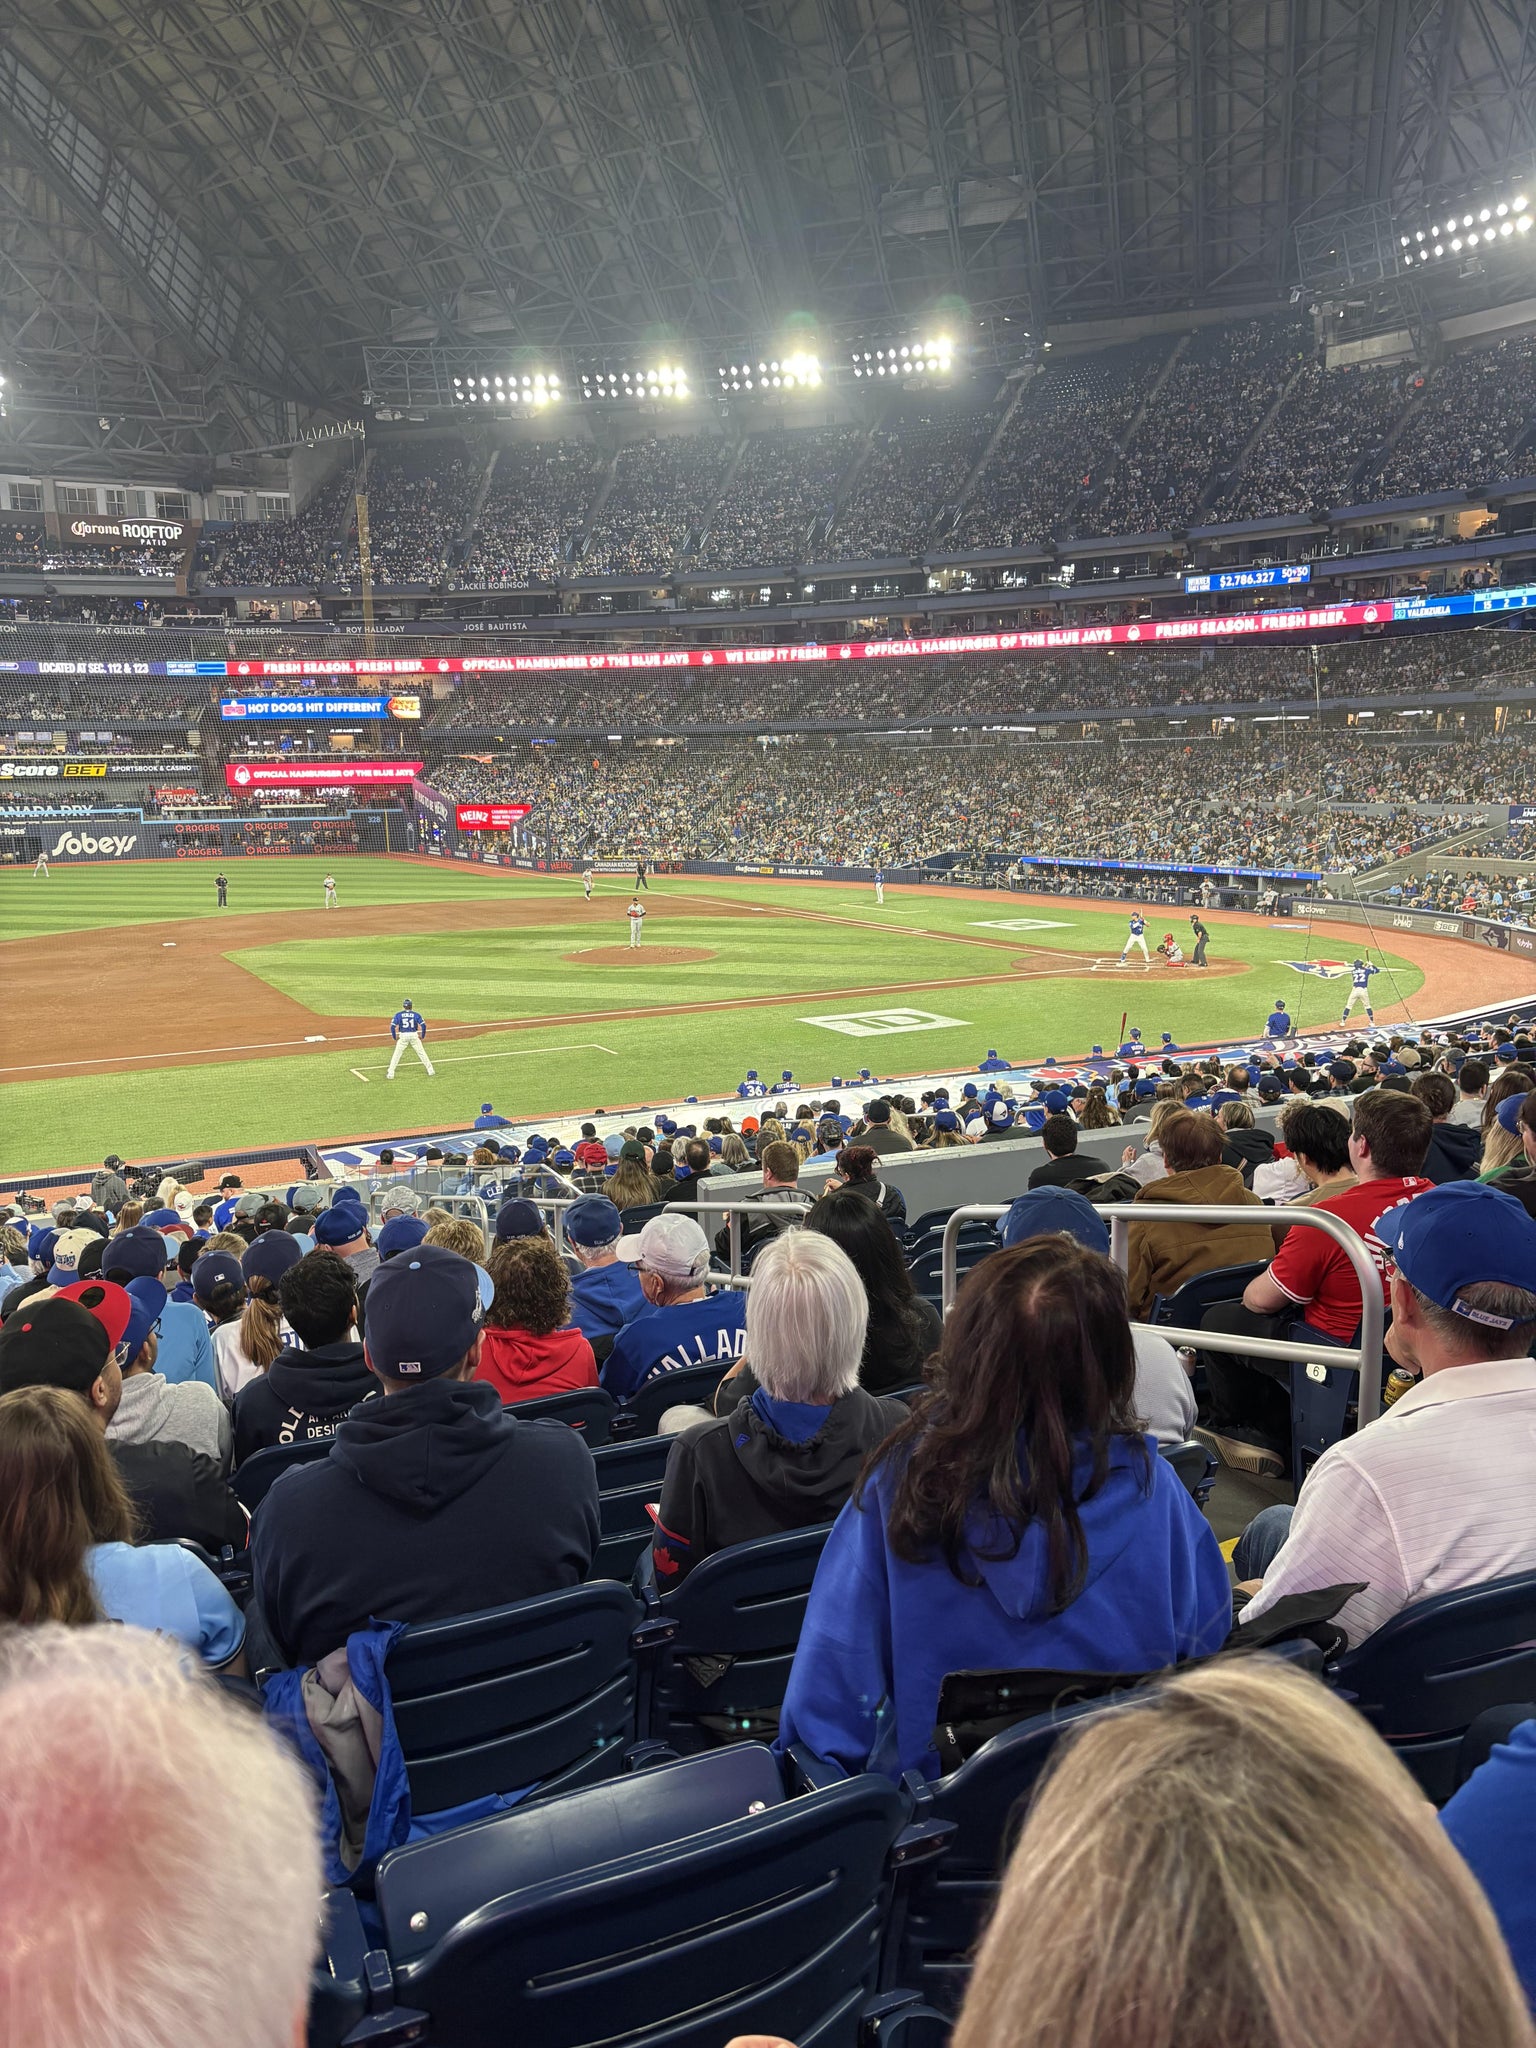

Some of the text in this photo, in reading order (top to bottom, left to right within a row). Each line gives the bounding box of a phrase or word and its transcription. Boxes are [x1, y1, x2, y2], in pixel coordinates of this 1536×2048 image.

[71, 521, 182, 539] Corona ROOFTOP
[459, 581, 529, 591] JACKIE ROBINSON
[1504, 599, 1510, 608] 2
[346, 626, 405, 634] ROY HALLADAY
[463, 621, 528, 631] JOSÉ BAUTISTA
[1156, 614, 1347, 636] FRESH SEASON. FRESH BEEF.
[865, 629, 1113, 657] OFFICIAL HAMBURGER OF THE BLUE JAYS
[726, 647, 827, 664] WE KEEP IT FRESH
[263, 661, 425, 674] FRESH SEASON. FRESH BEEF.
[462, 653, 690, 671] OFFICIAL HAMBURGER OF THE BLUE JAYS
[39, 662, 149, 674] LOCATED AT SEC. 112 & 123
[248, 704, 269, 714] HOT
[271, 704, 304, 713] DOGS
[306, 704, 323, 713] HIT
[326, 702, 382, 713] DIFFERENT
[65, 764, 106, 776] BET
[112, 765, 158, 773] SPORTSBOOK
[159, 764, 165, 772] &
[253, 771, 289, 779] OFFICIAL
[289, 770, 342, 779] HAMBURGER
[373, 769, 391, 777] BLUE
[393, 769, 415, 777] JAYS
[66, 804, 94, 817] DRY
[368, 815, 381, 823] 328
[460, 810, 489, 823] HEINZ
[185, 824, 220, 833] ROGERS
[255, 822, 289, 831] ROGERS
[322, 820, 356, 829] ROGERS
[52, 831, 137, 856] Sobeys
[188, 848, 223, 857] ROGERS
[256, 846, 291, 855] ROGERS
[550, 861, 573, 871] HEINZ
[1305, 905, 1326, 915] clover
[1393, 914, 1412, 928] KPMG
[1353, 973, 1366, 983] 22
[402, 1018, 415, 1028] 51
[746, 1085, 763, 1097] 36
[1471, 1311, 1508, 1326] BLUE JAYS
[1313, 1366, 1320, 1377] 6
[307, 1424, 340, 1439] DESI
